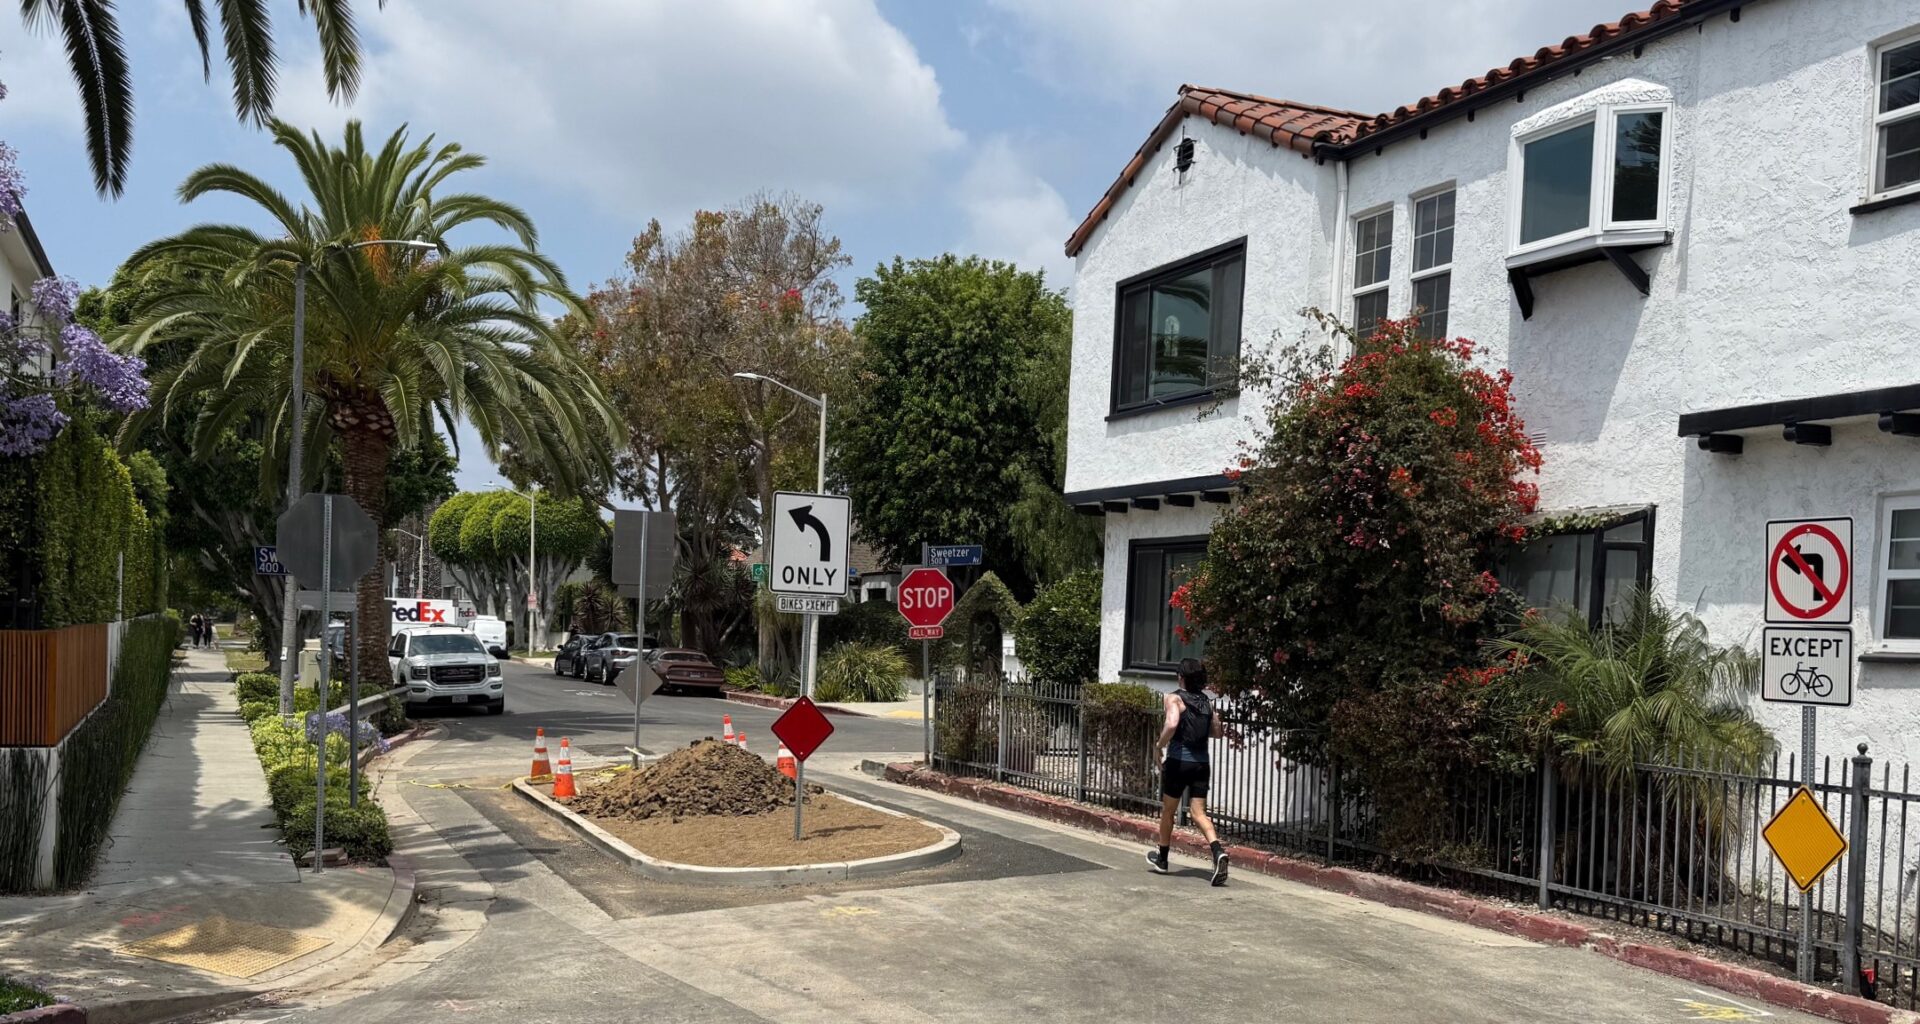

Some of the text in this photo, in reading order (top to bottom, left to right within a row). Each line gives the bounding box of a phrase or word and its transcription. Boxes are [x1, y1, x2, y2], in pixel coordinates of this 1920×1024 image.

[930, 548, 969, 557] Sweetzer
[259, 562, 279, 573] 400
[782, 565, 837, 586] ONLY
[780, 598, 836, 612] BIKES EXEMPT
[902, 587, 950, 609] STOP
[912, 628, 940, 636] ALL WAY
[1771, 637, 1842, 658] EXCEPT
